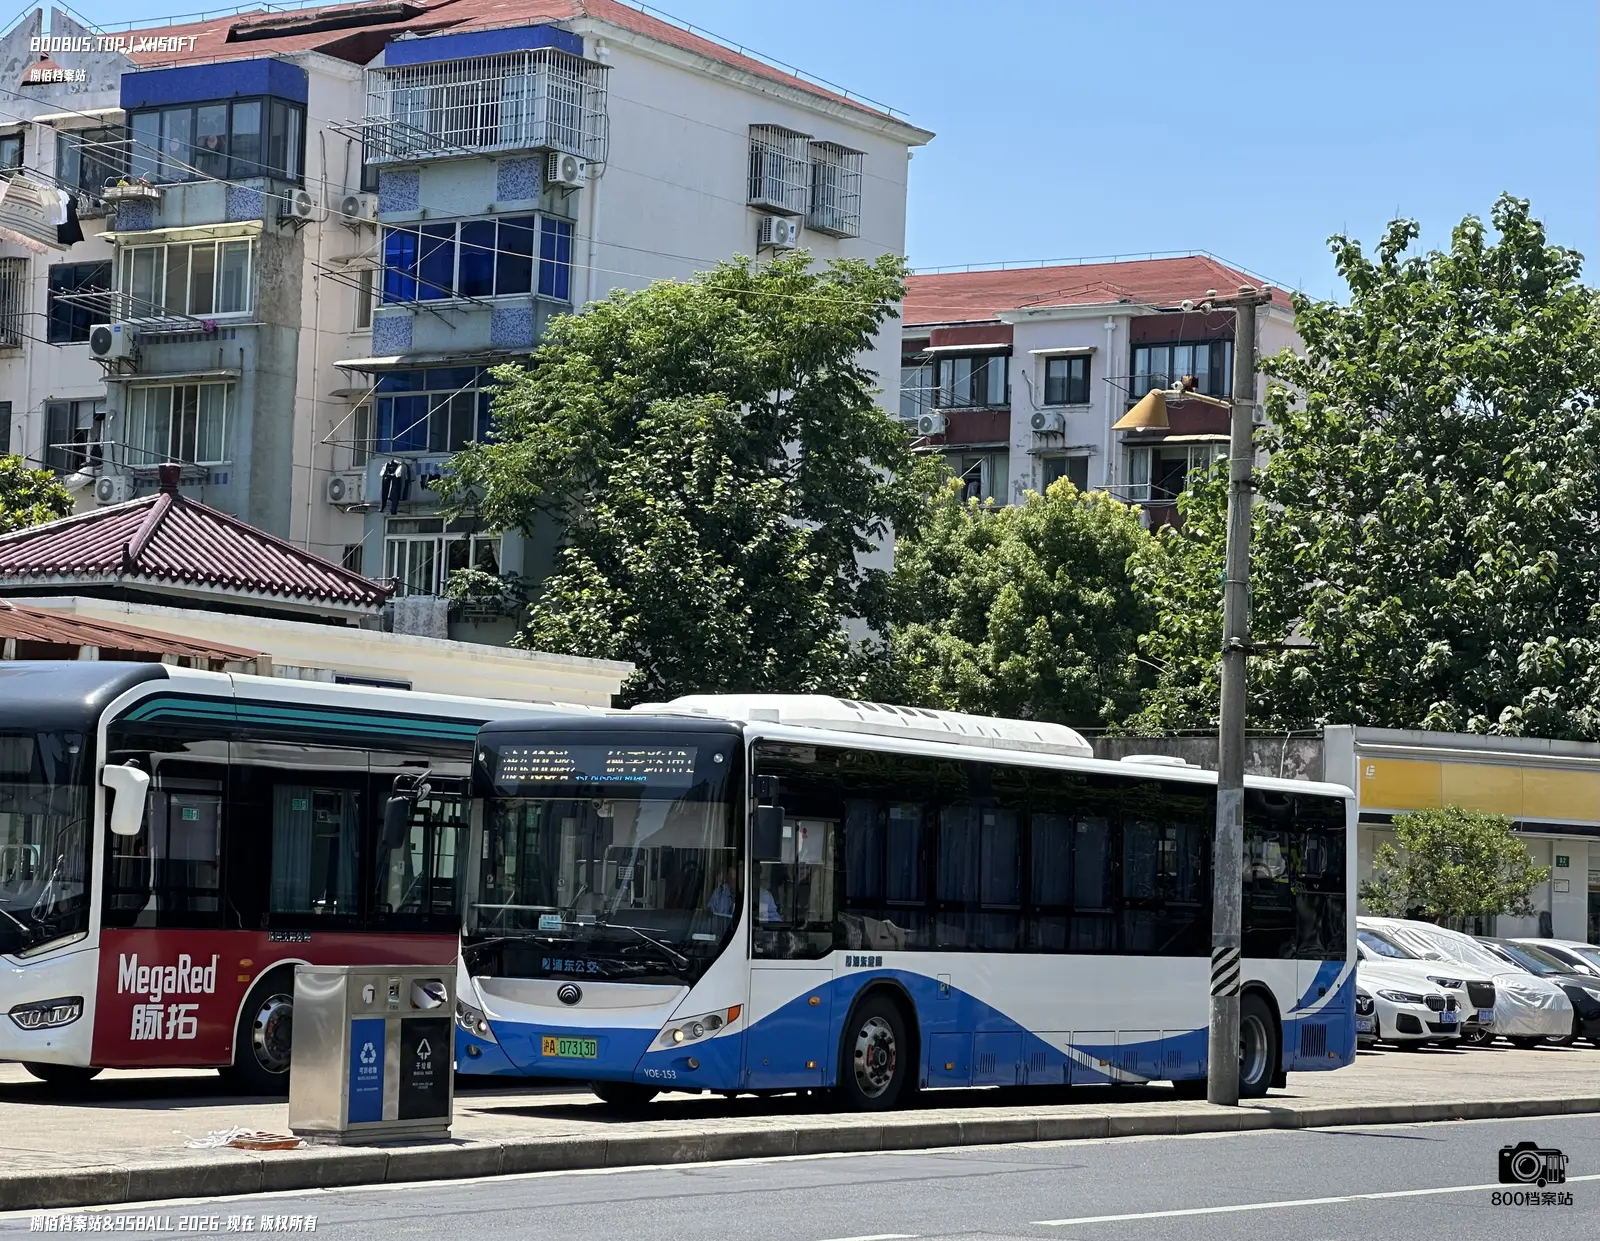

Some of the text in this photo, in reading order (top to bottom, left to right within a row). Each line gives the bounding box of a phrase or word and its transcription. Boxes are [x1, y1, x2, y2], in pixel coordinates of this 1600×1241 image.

[118, 953, 217, 1002] MegaRed
[553, 959, 598, 973] 浦东公交
[130, 1003, 199, 1040] 脉拓
[644, 1068, 677, 1079] YOE-153
